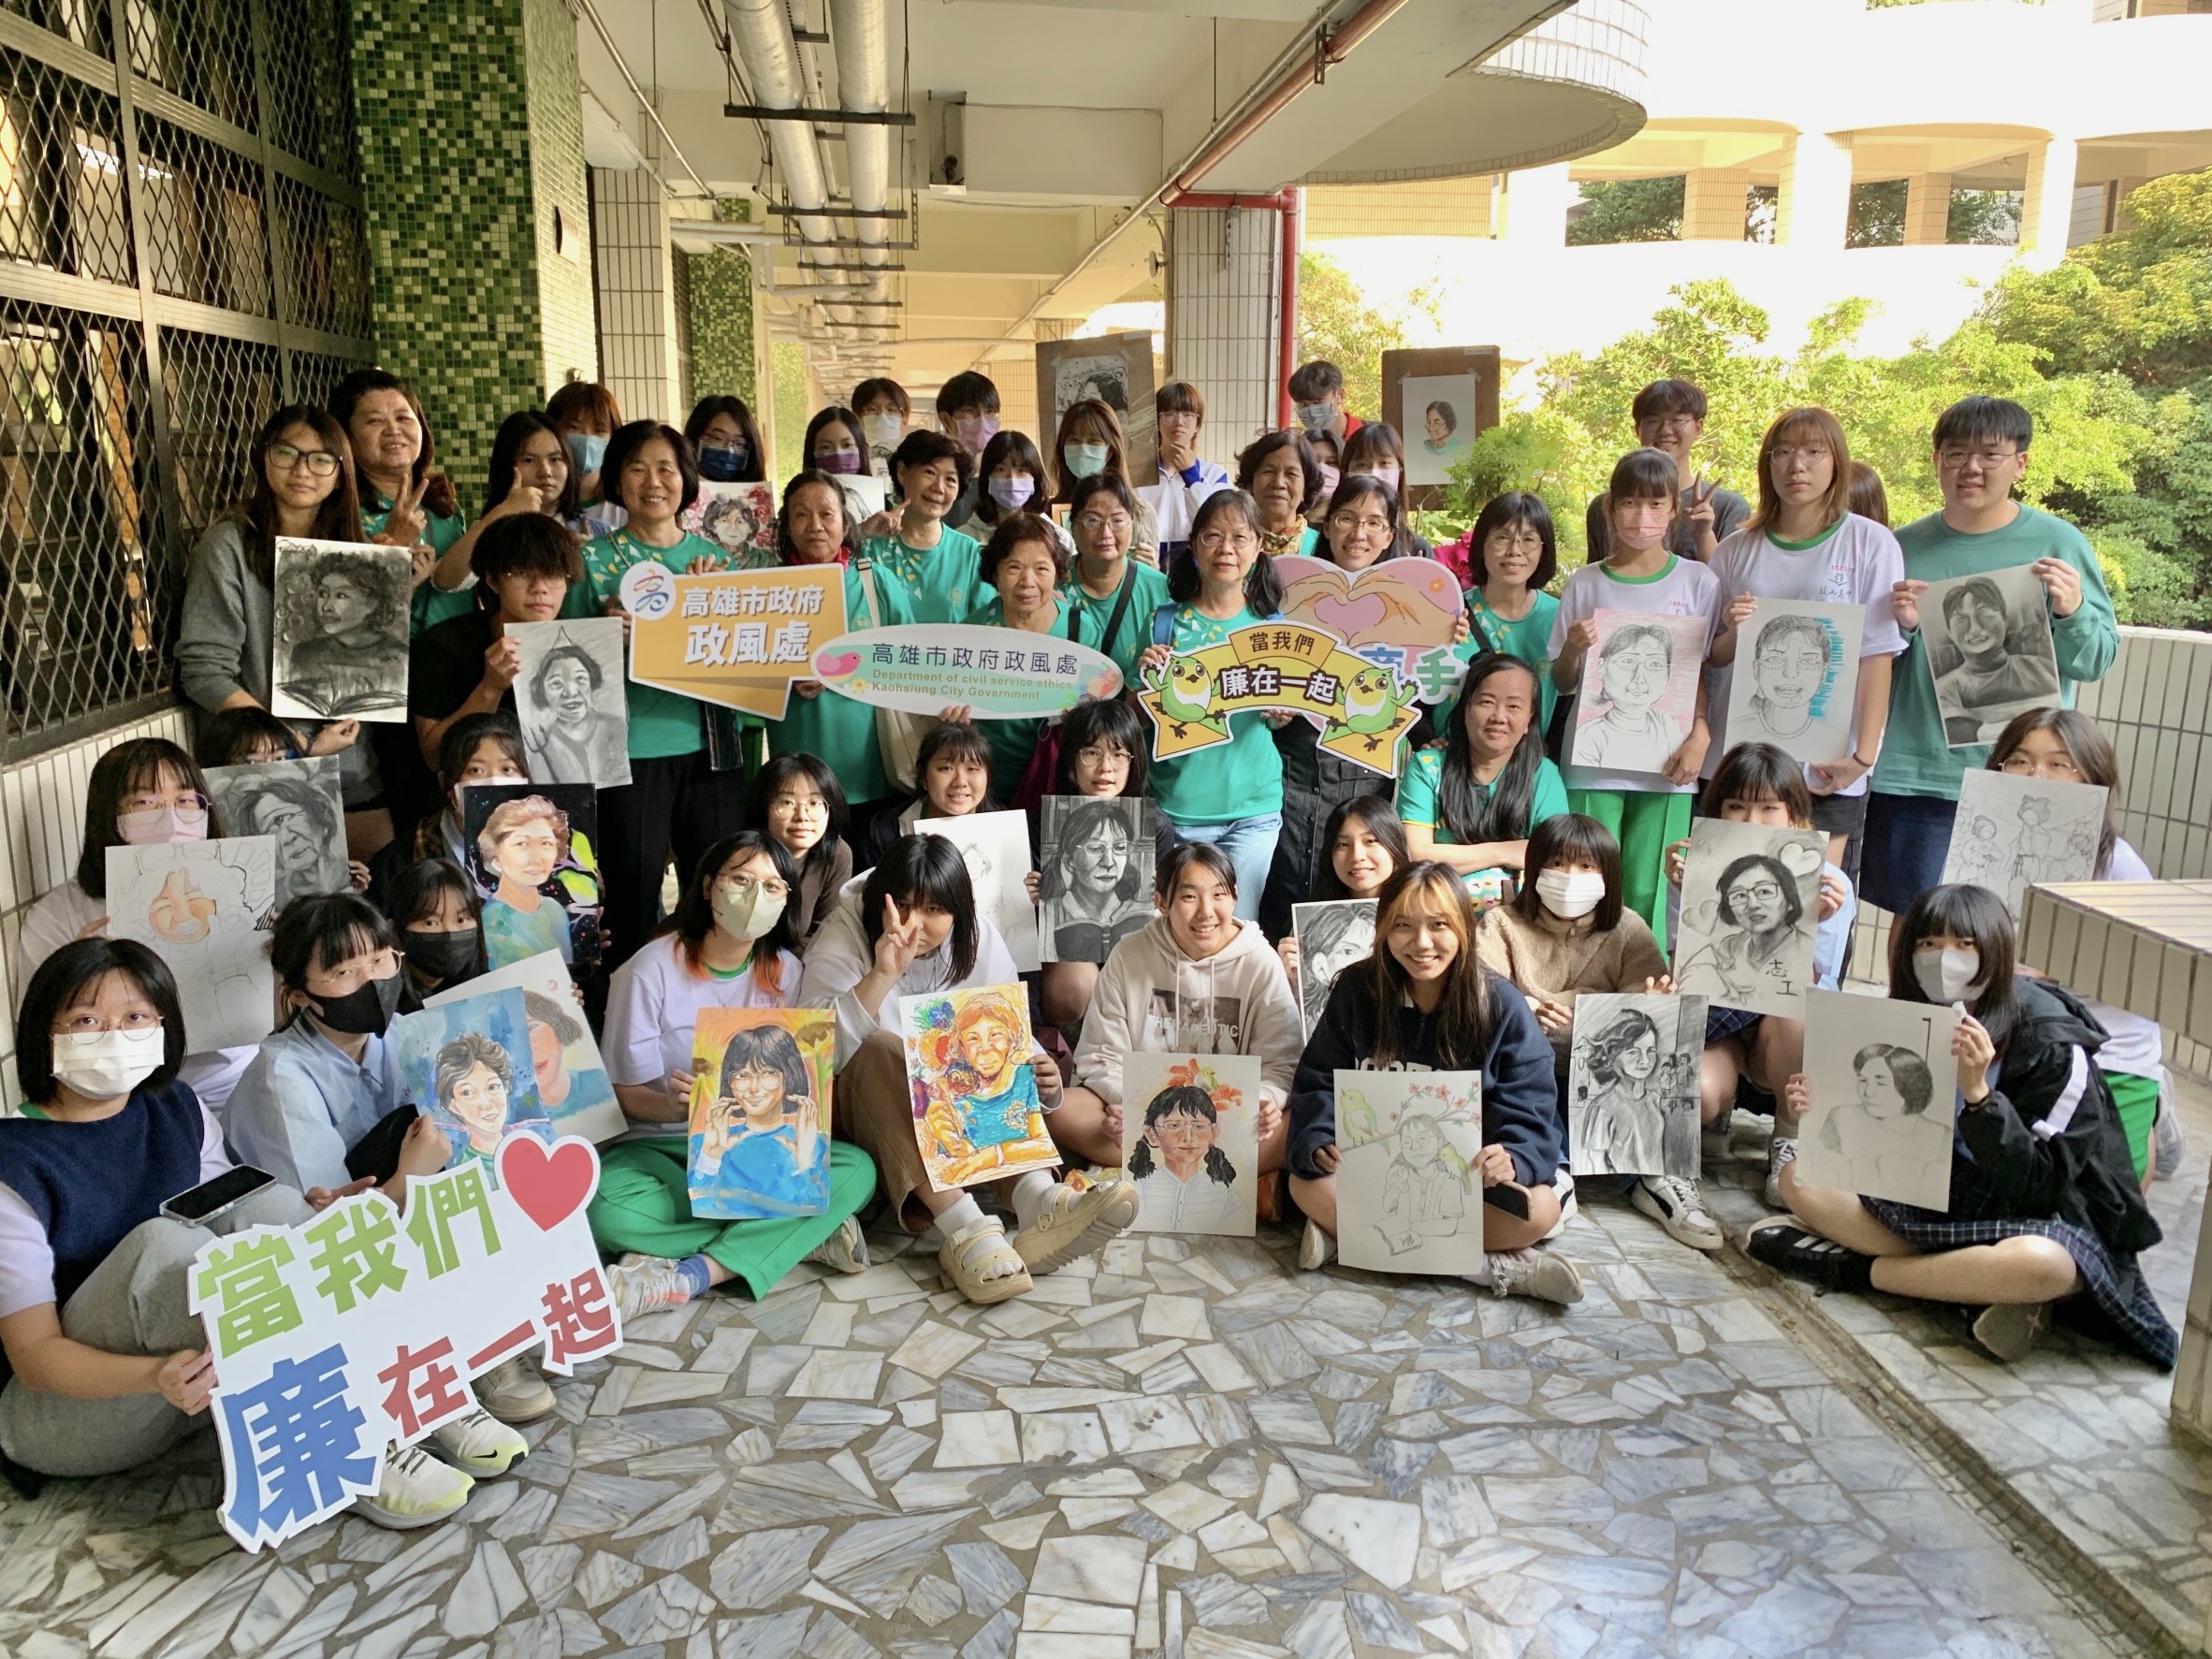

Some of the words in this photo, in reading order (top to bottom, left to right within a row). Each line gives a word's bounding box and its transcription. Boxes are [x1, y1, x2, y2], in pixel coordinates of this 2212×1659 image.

[681, 584, 824, 618] 高雄市政府
[685, 619, 812, 667] 政風處
[872, 643, 1078, 675] 高雄市政府政風處
[1249, 631, 1315, 656] 當我們
[872, 682, 937, 696] Kaohsiung
[940, 685, 964, 698] City
[968, 687, 1041, 700] Government
[873, 669, 942, 682] Department
[946, 673, 959, 682] of
[962, 674, 987, 684] civil
[990, 677, 1033, 687] service
[1037, 678, 1072, 689] ethics
[1221, 666, 1338, 704] 廉在一起
[197, 1167, 502, 1359] 當我們
[220, 1267, 618, 1539] 廉在一起
